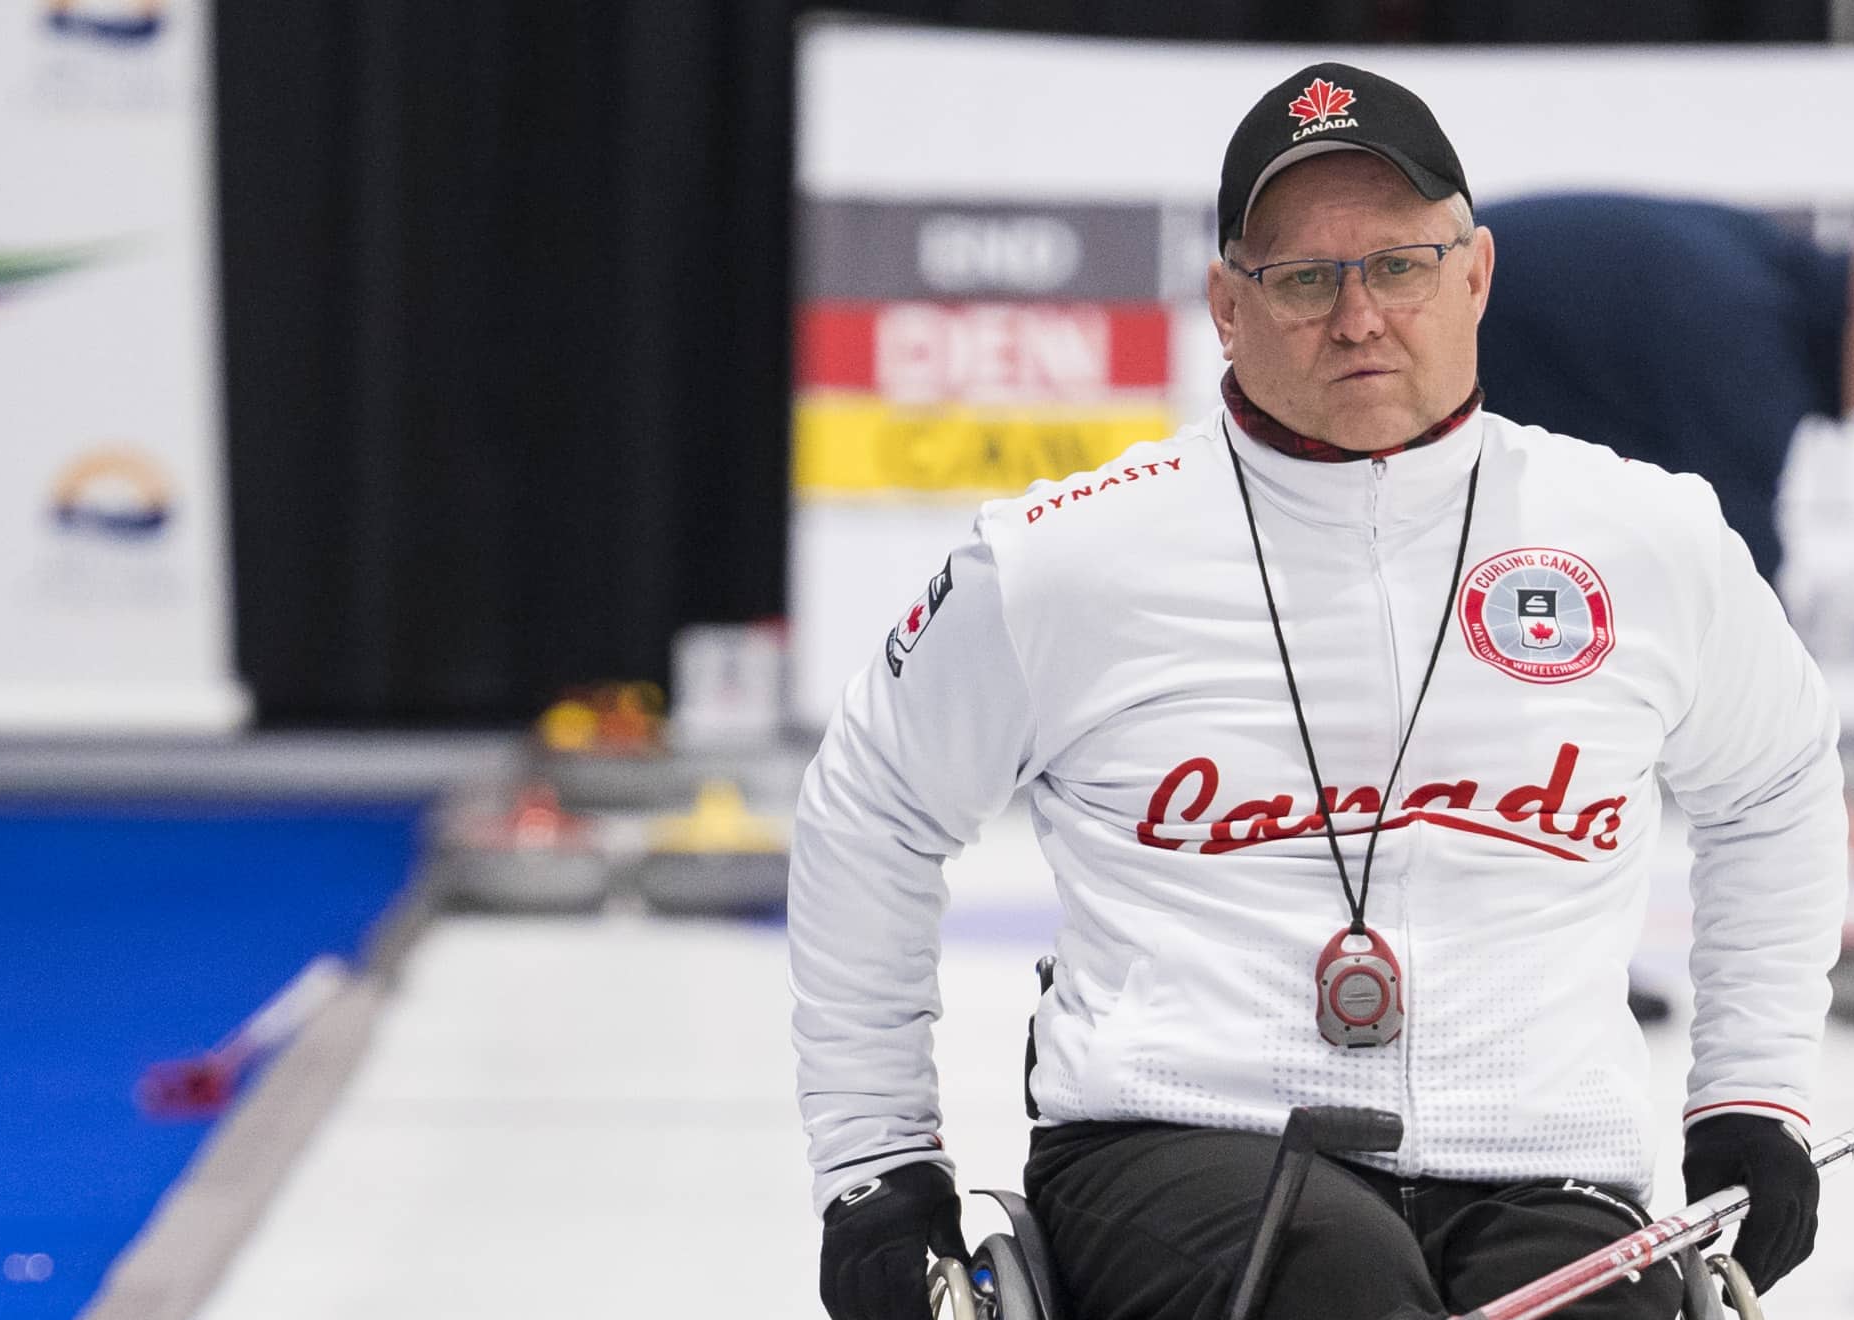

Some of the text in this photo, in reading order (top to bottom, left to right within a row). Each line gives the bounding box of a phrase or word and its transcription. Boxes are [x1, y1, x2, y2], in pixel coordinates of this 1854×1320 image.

[1292, 117, 1359, 142] CANADA
[875, 303, 1110, 402] DEN
[1025, 457, 1181, 524] DYNASTY
[1474, 554, 1595, 593] CURLING CANADA
[1471, 623, 1508, 666] NATIONAL
[1136, 743, 1627, 860] Canada
